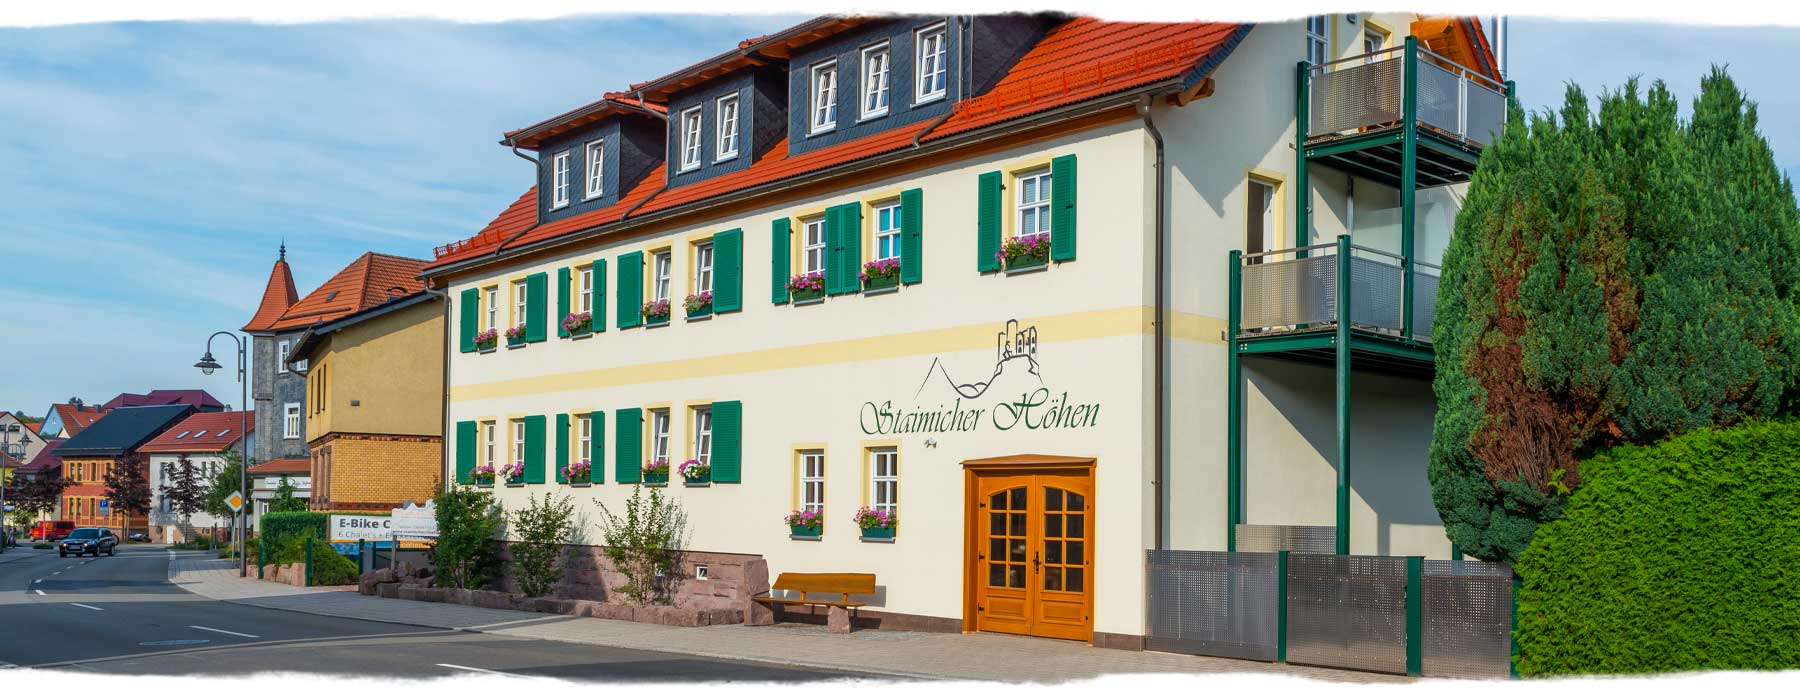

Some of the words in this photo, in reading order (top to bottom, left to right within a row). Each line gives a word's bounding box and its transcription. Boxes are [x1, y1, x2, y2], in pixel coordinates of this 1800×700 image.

[860, 398, 985, 435] Staimicher
[992, 387, 1100, 430] Höhen
[340, 518, 379, 528] E-Bike
